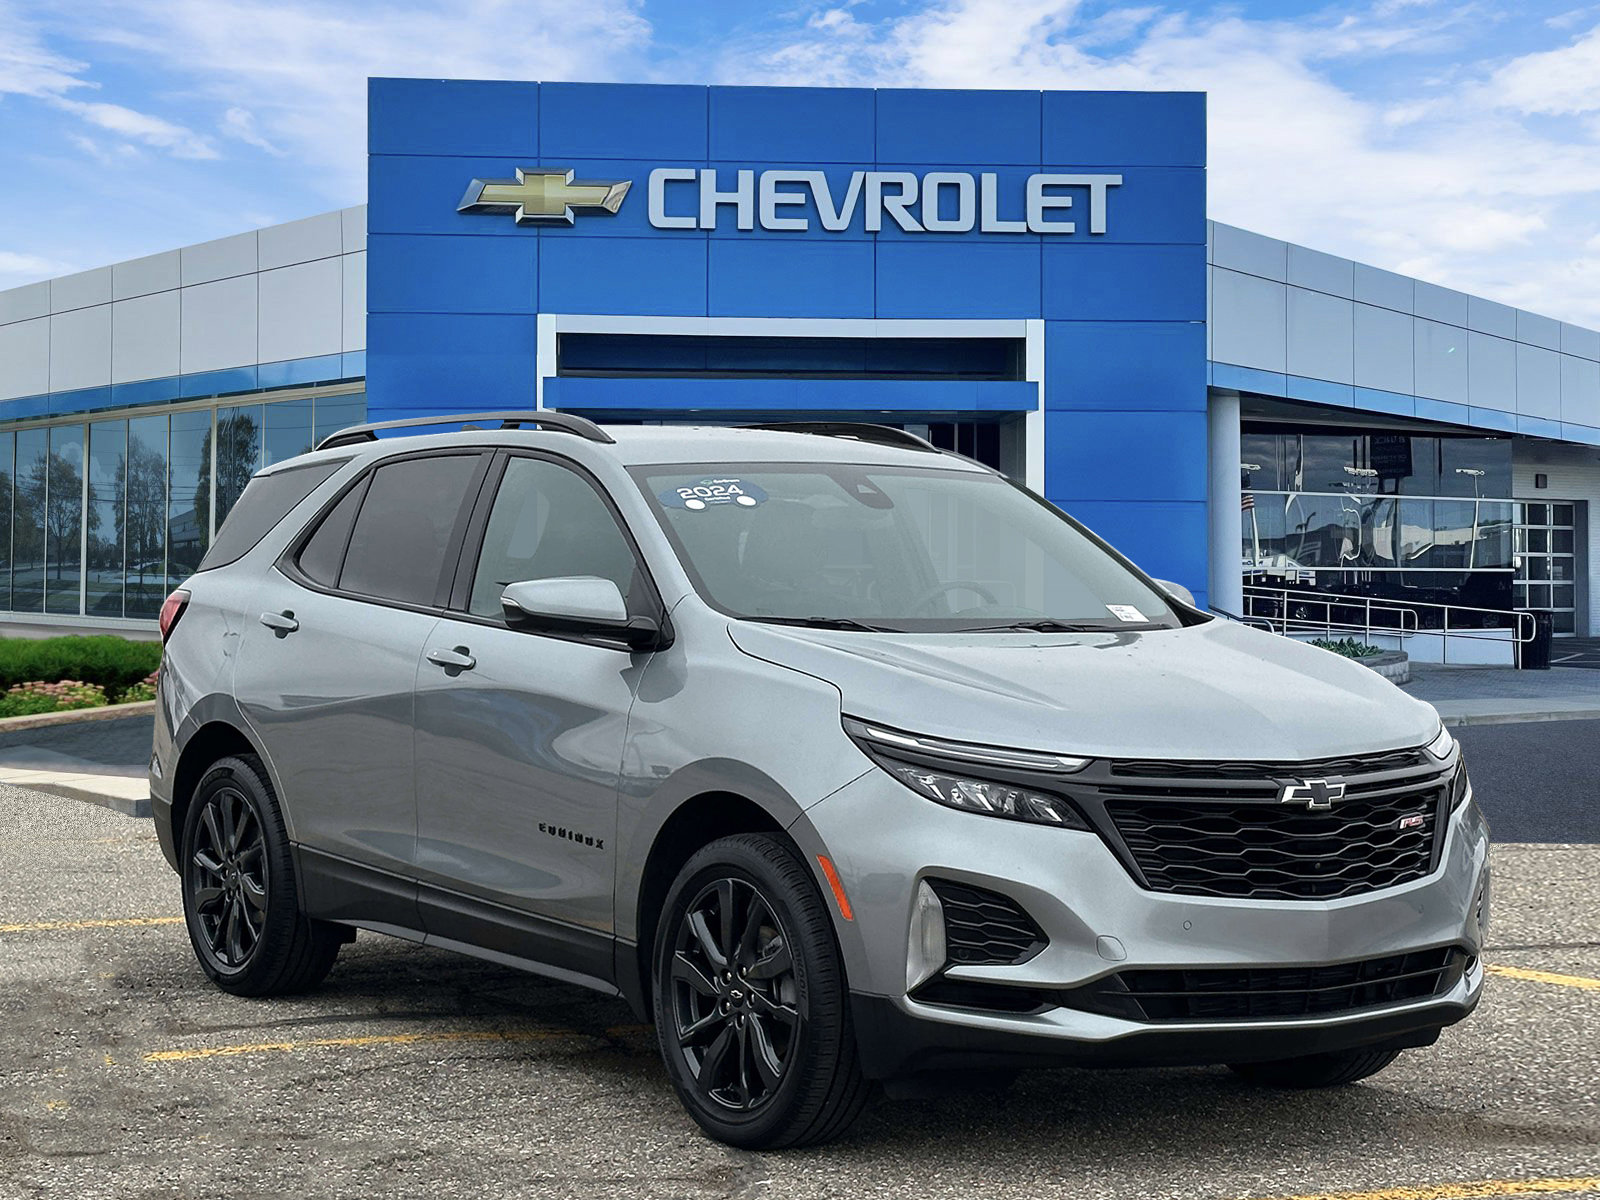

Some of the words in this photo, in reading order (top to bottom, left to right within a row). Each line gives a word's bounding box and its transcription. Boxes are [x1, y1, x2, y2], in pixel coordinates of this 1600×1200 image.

[648, 168, 1123, 235] CHEVROLET
[676, 485, 743, 499] 2024
[538, 823, 604, 849] EQUINOX
